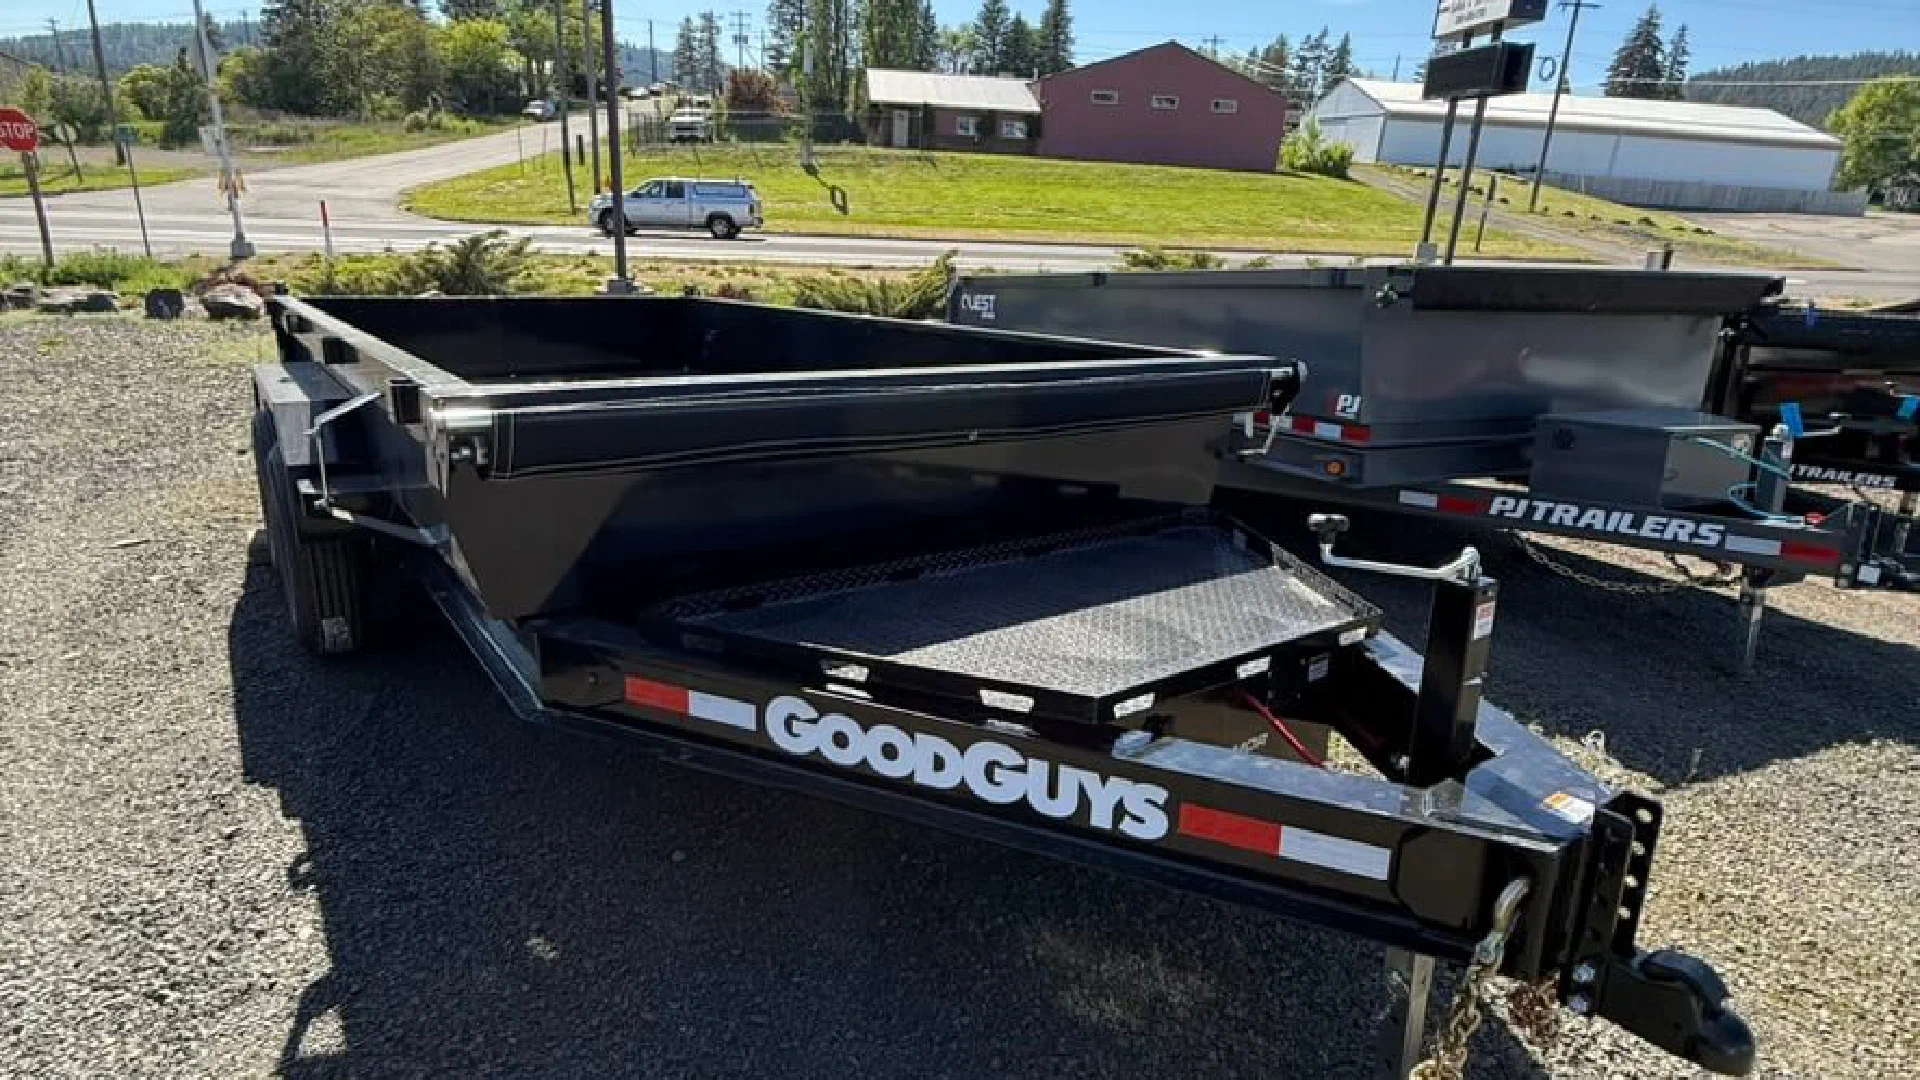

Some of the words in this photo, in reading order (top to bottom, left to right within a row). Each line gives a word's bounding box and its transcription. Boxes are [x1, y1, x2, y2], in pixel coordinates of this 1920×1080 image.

[0, 121, 33, 139] STOP
[1336, 394, 1361, 413] PJ
[1798, 463, 1897, 487] TRAILERS
[1488, 496, 1529, 519] PJ
[1531, 499, 1726, 546] TRAILERS
